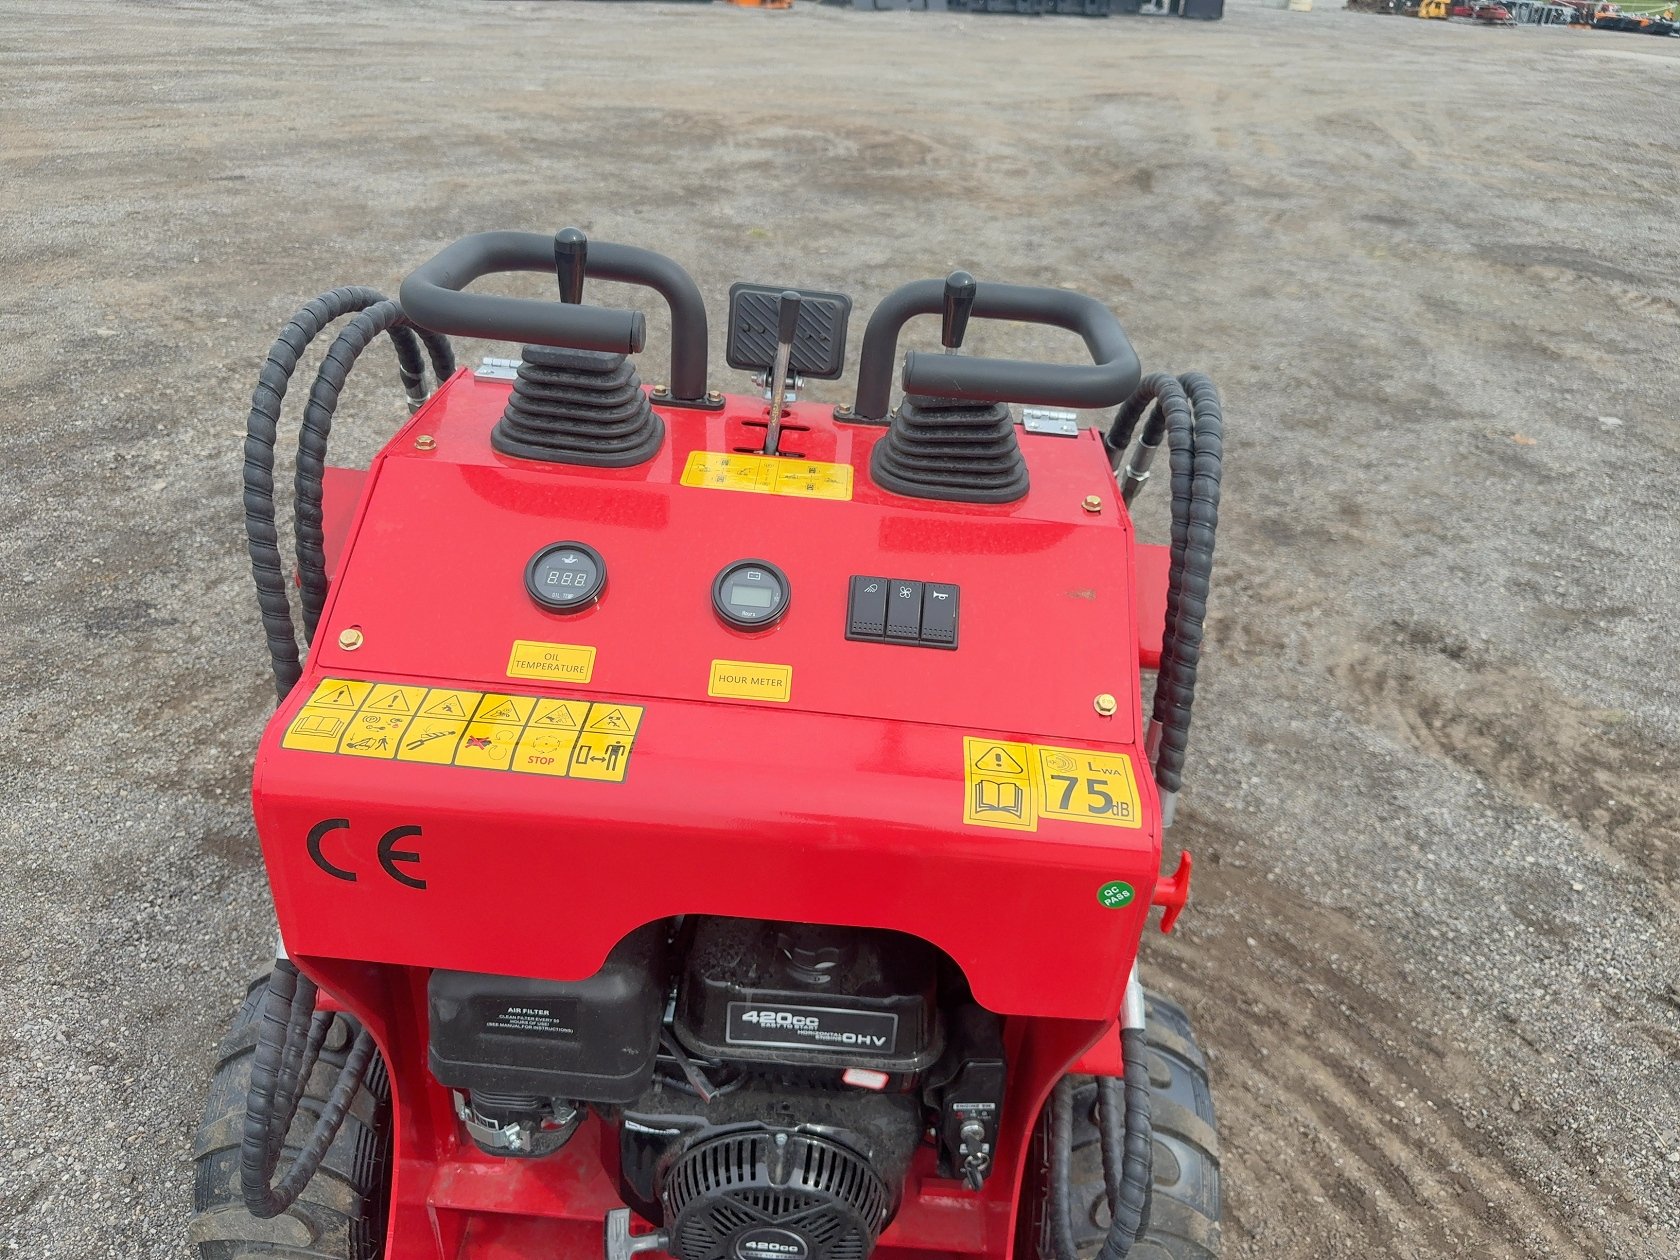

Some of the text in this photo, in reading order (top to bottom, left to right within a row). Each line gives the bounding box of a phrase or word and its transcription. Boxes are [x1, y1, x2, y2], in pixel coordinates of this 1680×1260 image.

[544, 653, 560, 662] OIL
[516, 660, 585, 674] TEMPERATURE
[718, 675, 783, 687] HOUR METER
[527, 755, 555, 765] STOP
[306, 818, 427, 890] CE
[1104, 886, 1119, 897] QC
[1104, 890, 1130, 906] PASS
[522, 1008, 550, 1016] FILTER
[742, 1010, 819, 1026] 420cc
[533, 1025, 574, 1034] INSTRUCTIONS)
[797, 1029, 842, 1037] HORIZONTAL
[842, 1032, 887, 1046] OHV
[745, 1241, 798, 1253] 420cc
